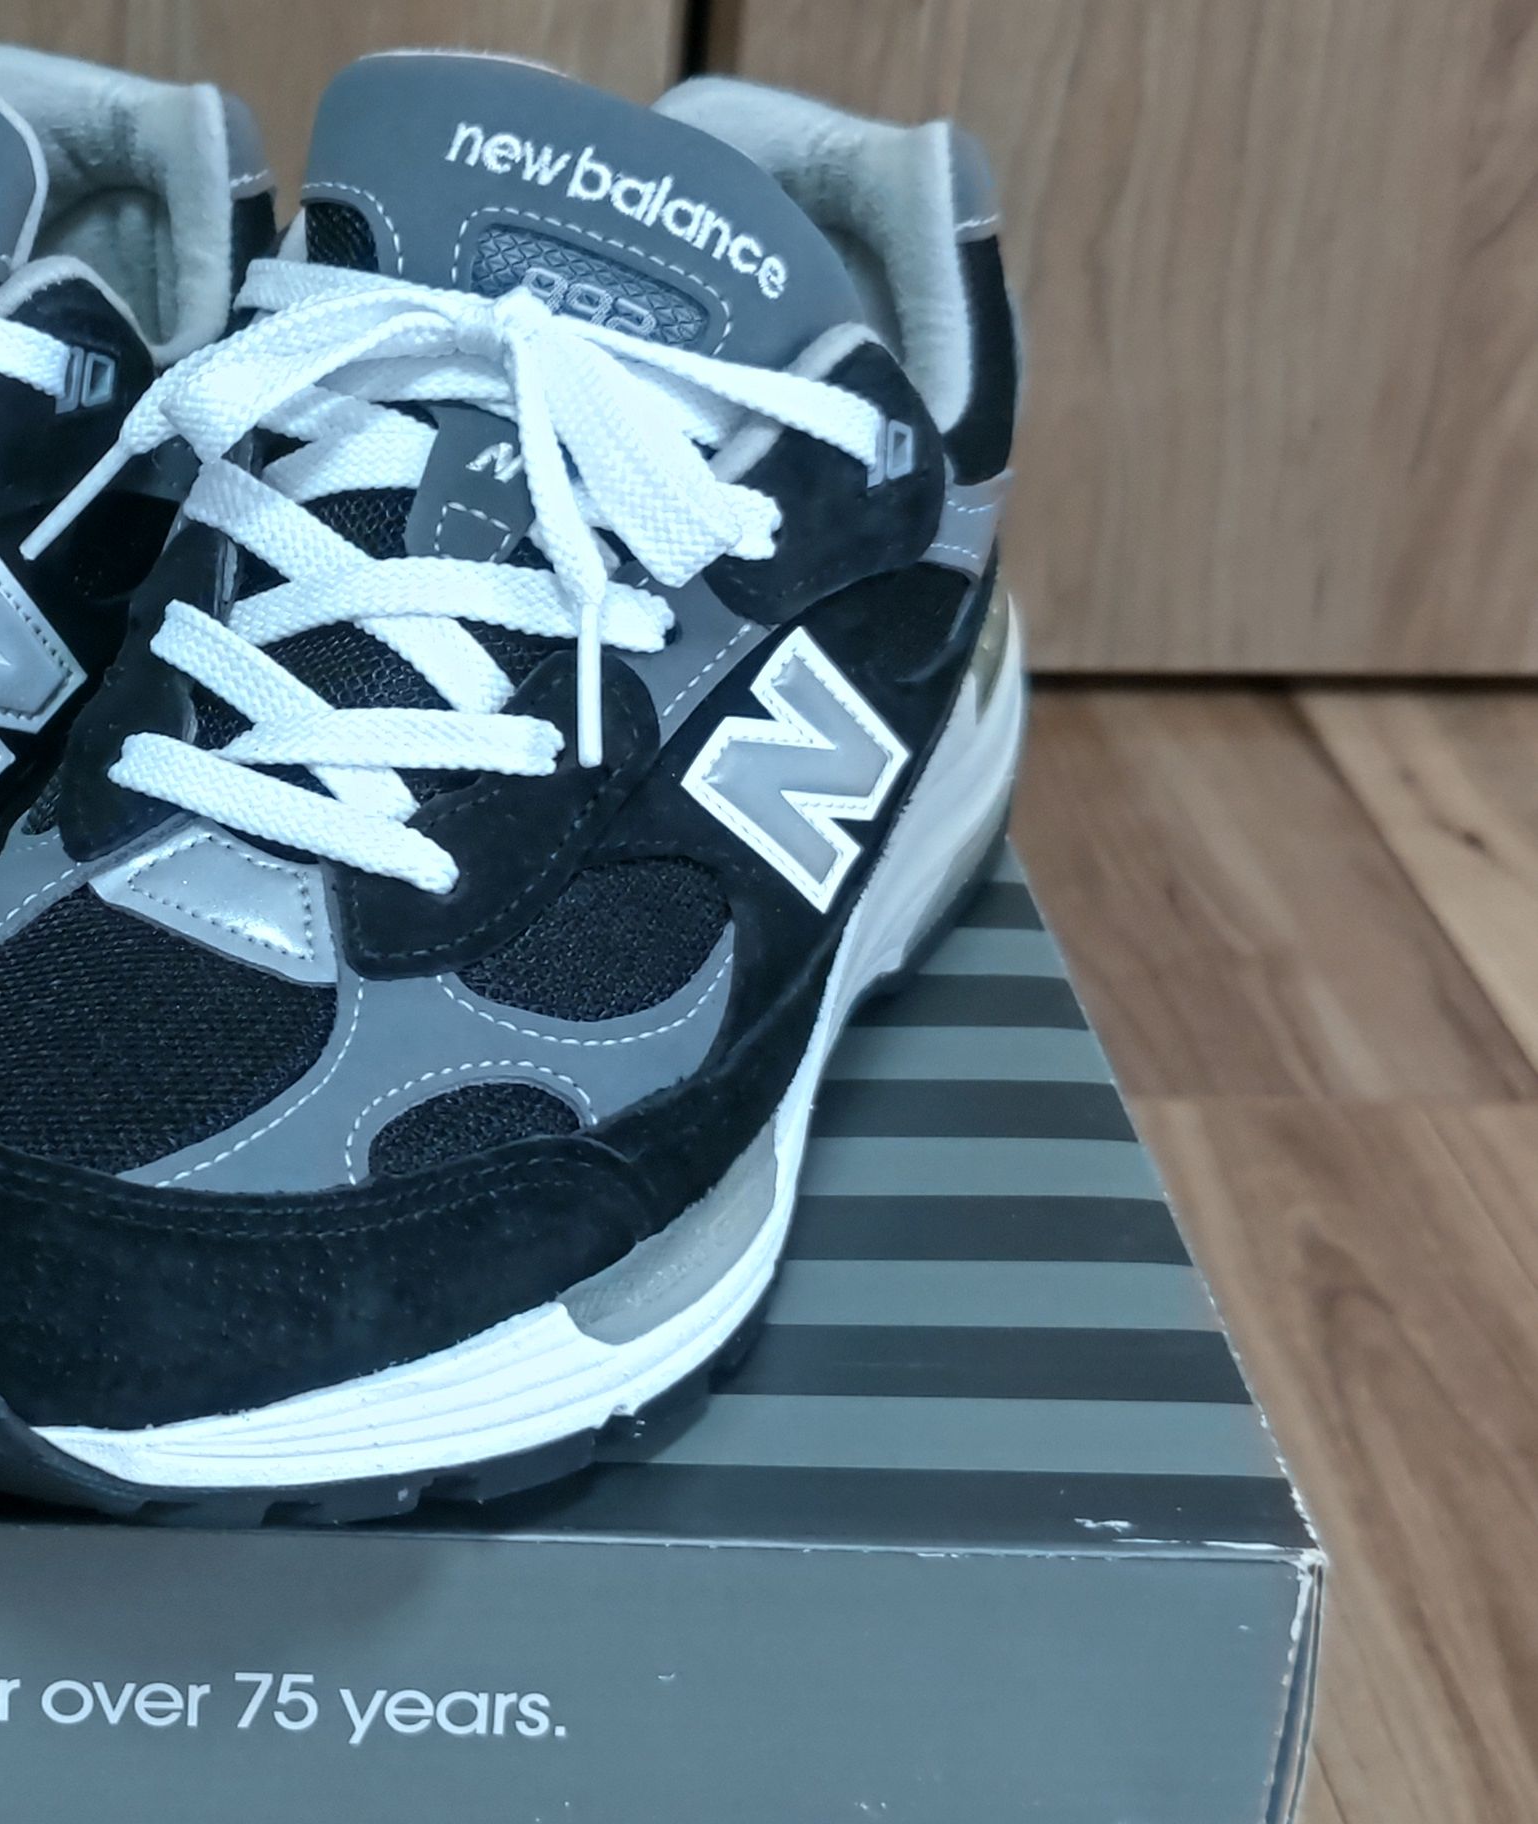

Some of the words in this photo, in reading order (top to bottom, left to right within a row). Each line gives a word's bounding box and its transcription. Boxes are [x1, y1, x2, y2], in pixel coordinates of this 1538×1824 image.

[445, 121, 573, 186] new
[566, 145, 788, 299] balance
[680, 626, 910, 914] N
[41, 1679, 211, 1727] over
[234, 1672, 318, 1731] 75
[339, 1687, 566, 1745] years.
